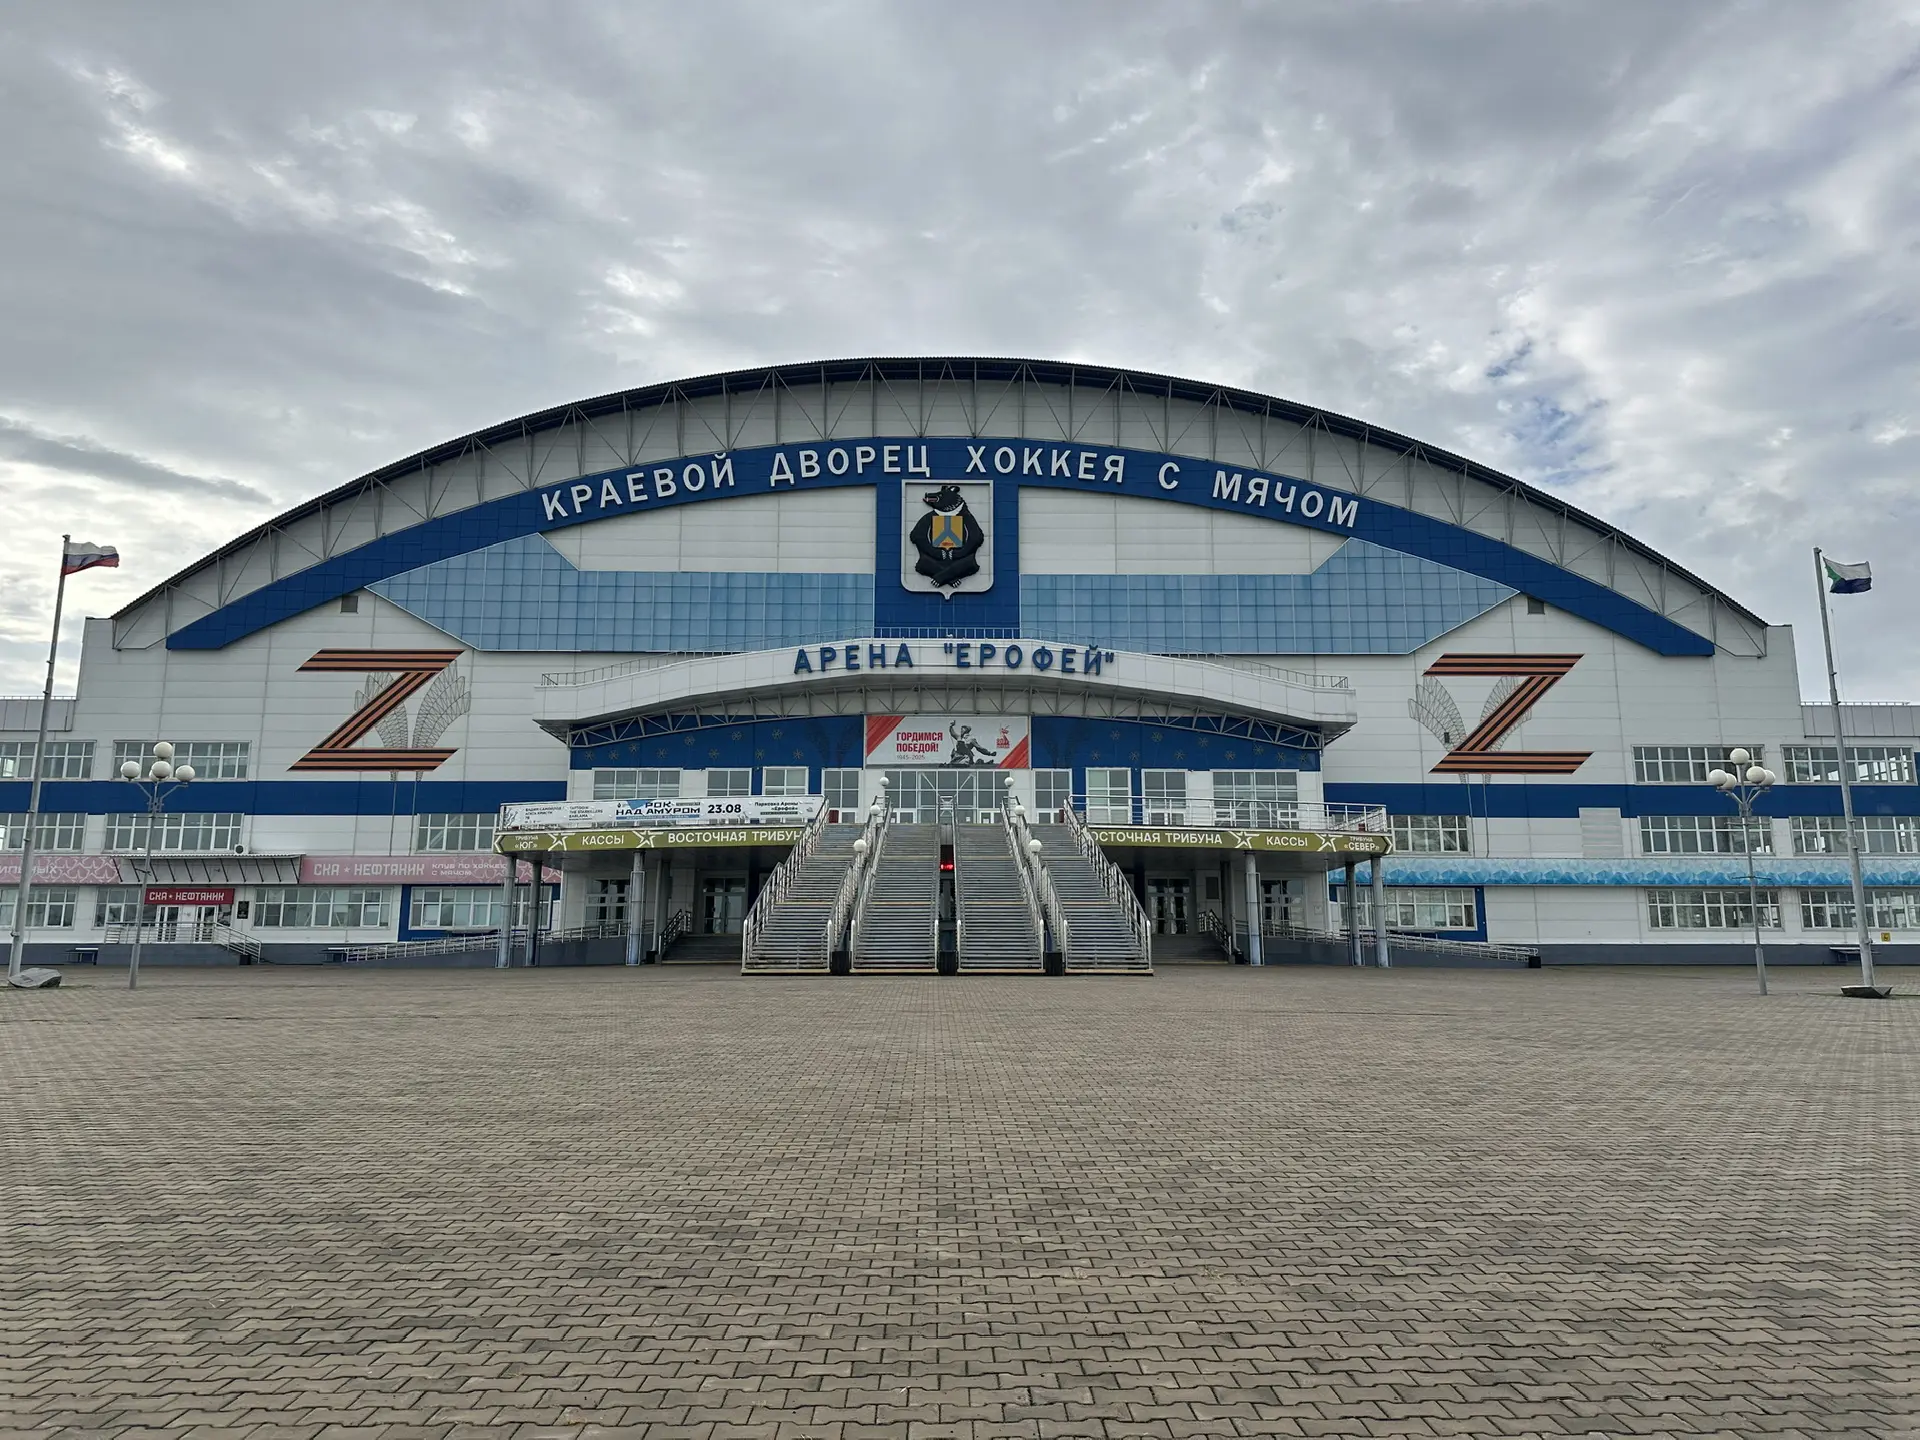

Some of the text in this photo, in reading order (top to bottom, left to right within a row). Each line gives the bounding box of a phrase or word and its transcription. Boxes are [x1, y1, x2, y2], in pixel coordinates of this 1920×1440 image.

[541, 445, 1359, 528] КРАЕВОЙ ДВОРЕЦ ХОККЕЯ С МЯЧОМ
[794, 643, 1114, 675] АРЕНА "ЕРОФЕЙ"
[896, 731, 943, 742] ГОРДИМСЯ
[896, 741, 939, 753] ПОБЕДОЙ!
[616, 807, 700, 816] НАД АМУРОМ
[707, 804, 742, 814] 23.08
[582, 835, 624, 845] КАССЫ
[668, 830, 802, 843] ВОСТОЧНАЯ ТРИБУН
[1091, 830, 1223, 844] ОСТОЧНАЯ ТРИБУНА
[1266, 836, 1308, 847] КАССЫ
[514, 841, 538, 849] «ЮГ»
[1344, 841, 1380, 851] «СЕВЕР»
[314, 863, 425, 876] СКА НЕФТЯНИК
[149, 891, 225, 901] СКА НЕФТЯНИК
